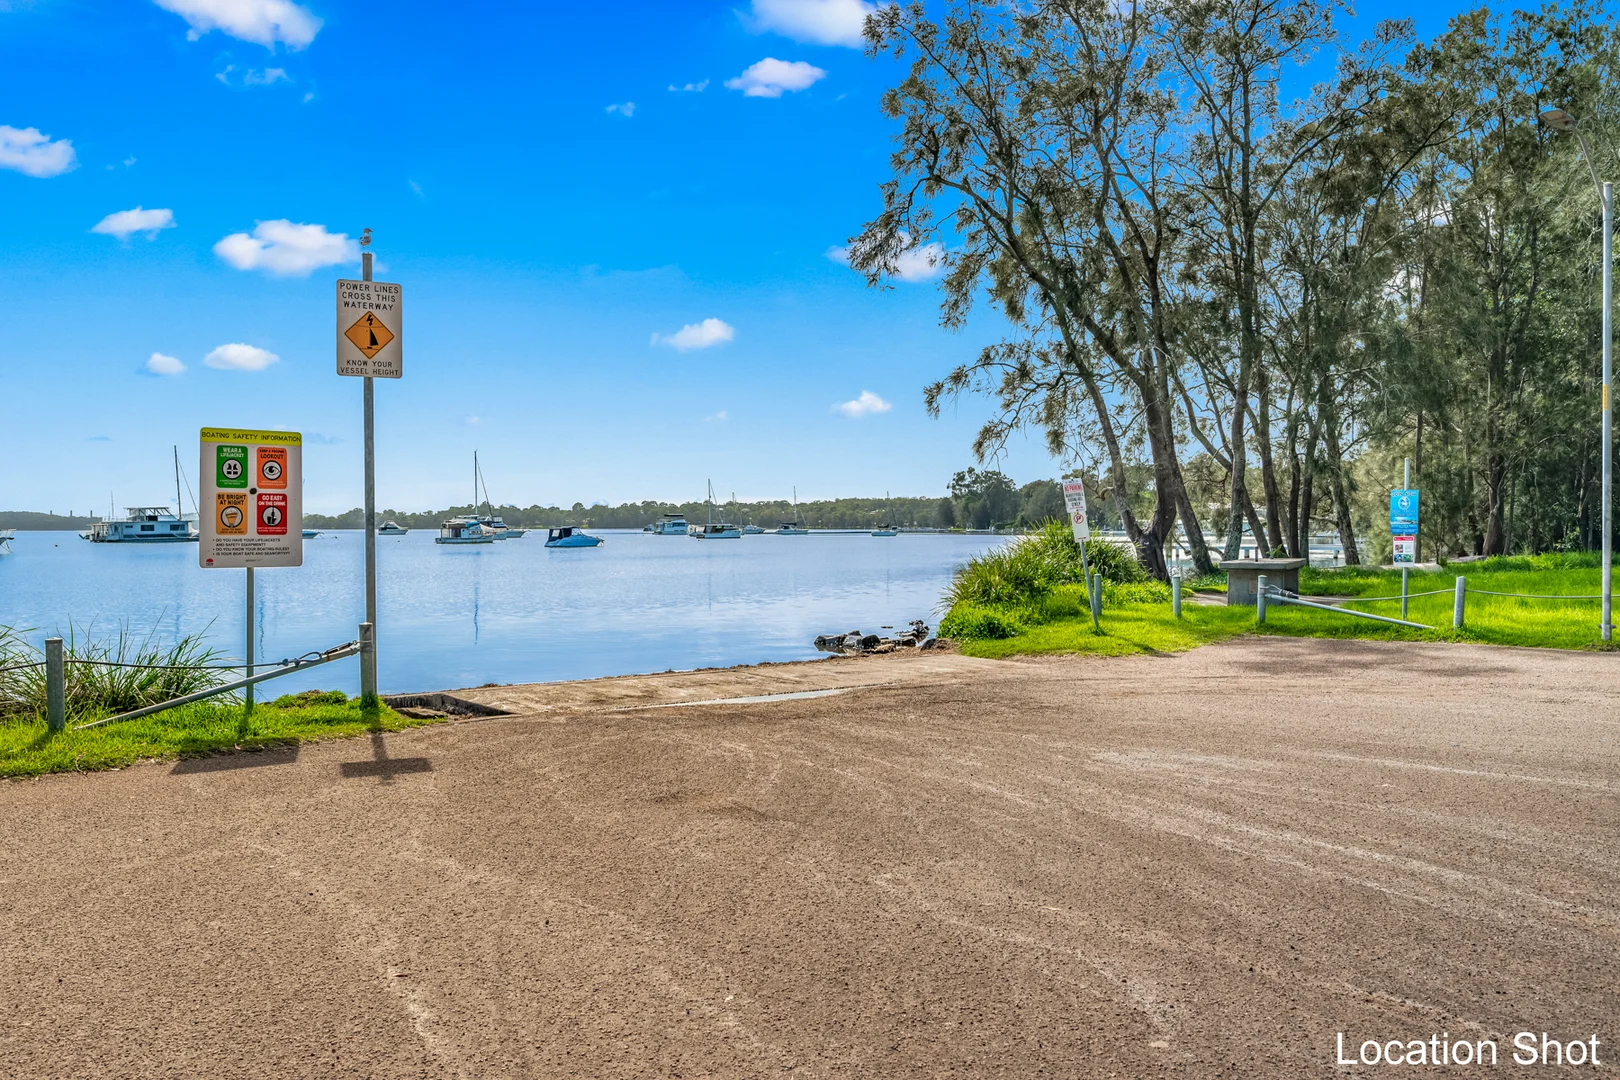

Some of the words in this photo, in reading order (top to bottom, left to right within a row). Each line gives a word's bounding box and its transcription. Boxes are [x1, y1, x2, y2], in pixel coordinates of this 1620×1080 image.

[340, 282, 370, 291] POWER
[374, 285, 399, 294] LINES
[342, 292, 371, 300] CROSS
[377, 294, 396, 302] THIS
[344, 301, 393, 311] WATERWAY
